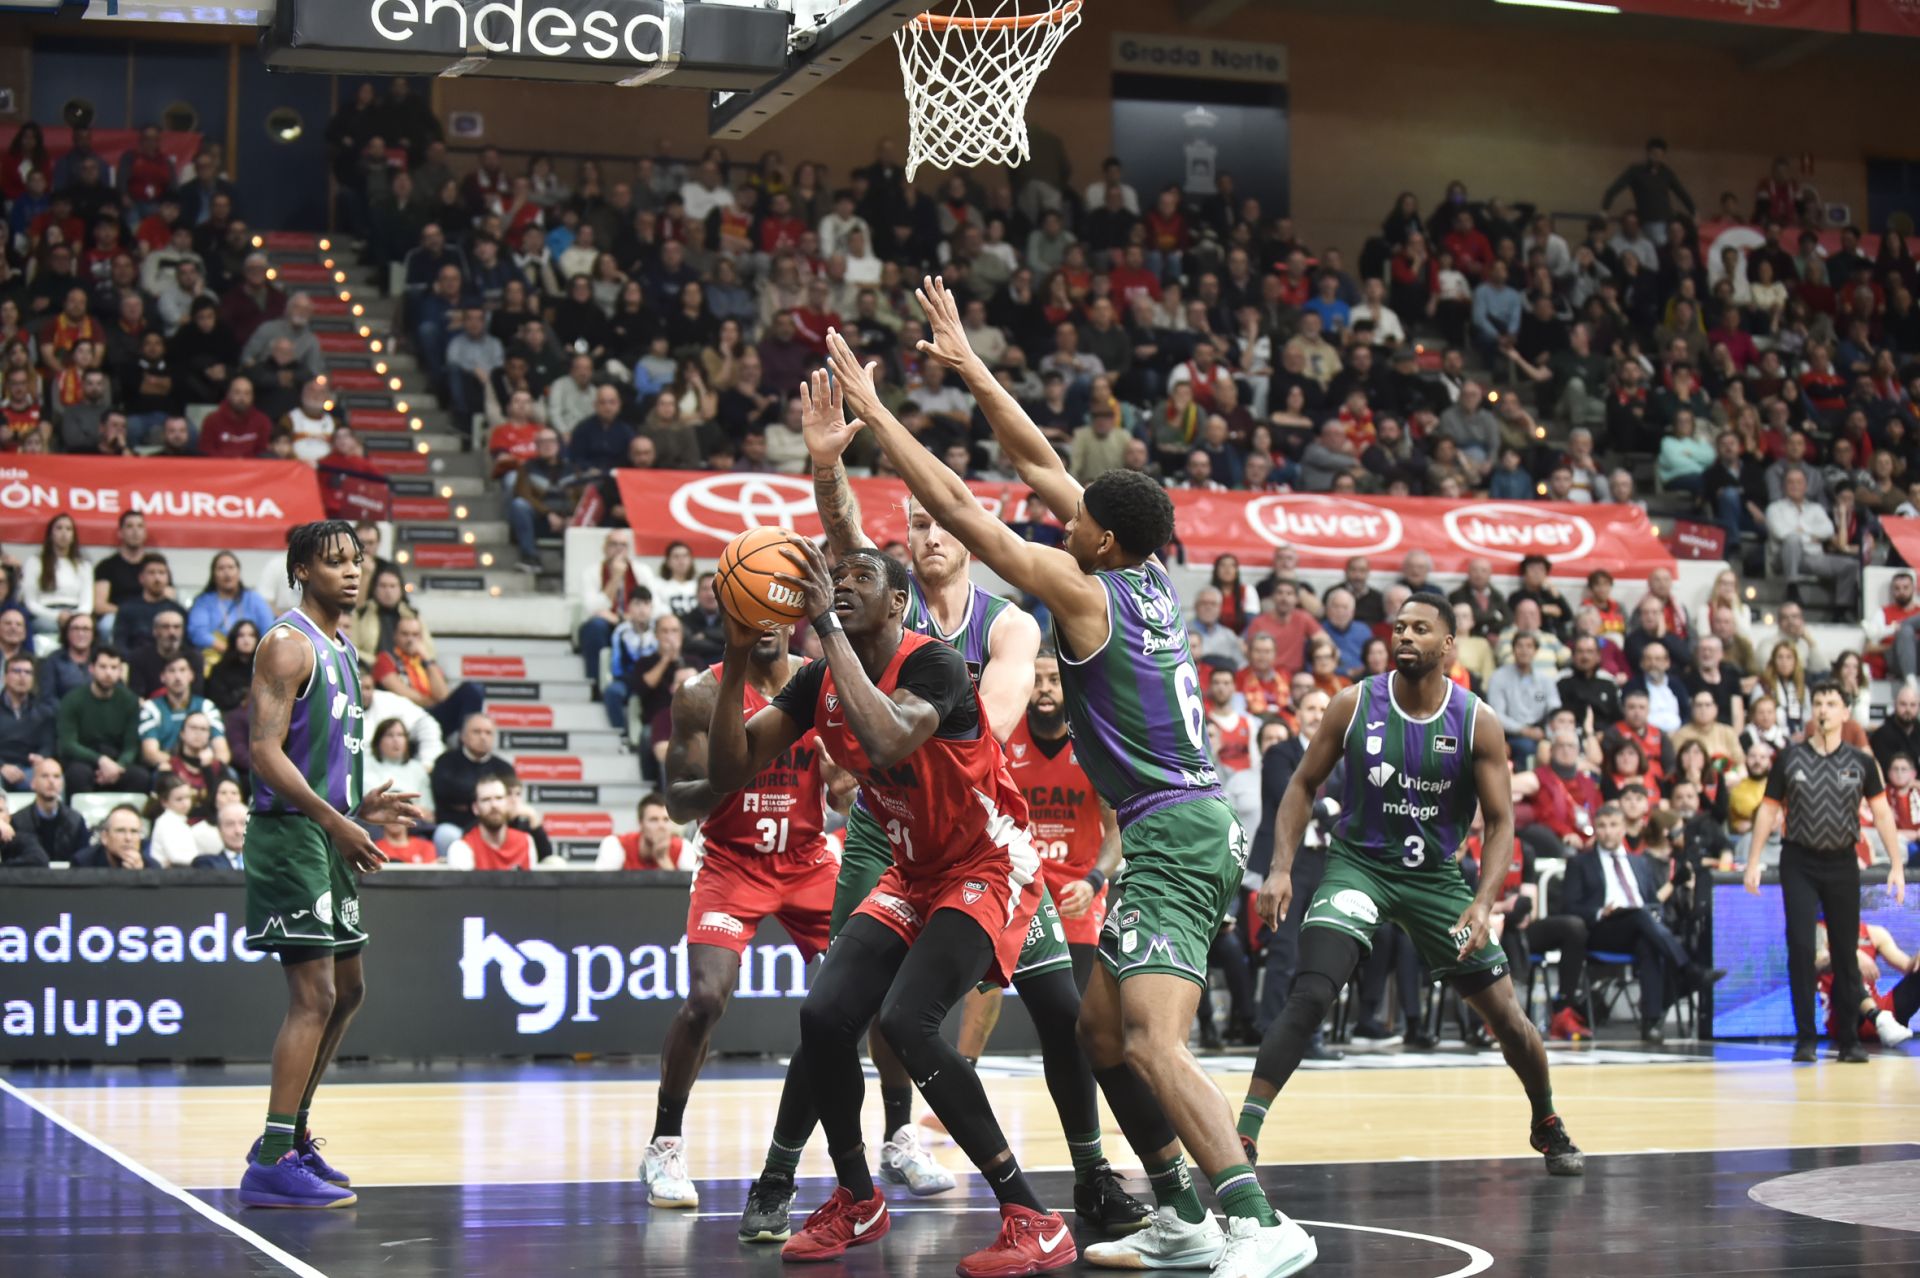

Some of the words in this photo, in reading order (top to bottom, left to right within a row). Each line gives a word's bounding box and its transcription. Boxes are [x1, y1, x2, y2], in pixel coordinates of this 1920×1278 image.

[371, 0, 671, 62] endesa
[1119, 40, 1200, 66] Grada
[1211, 47, 1280, 72] Norte
[69, 488, 120, 512] DE
[130, 491, 284, 518] MURCIA
[1268, 505, 1382, 539] Juver
[1464, 519, 1574, 547] Juver
[1174, 661, 1203, 749] 6
[1398, 772, 1452, 794] Unicaja
[755, 817, 789, 854] 31
[1402, 835, 1426, 868] 3
[966, 881, 982, 890] acb
[2, 986, 184, 1047] alupe
